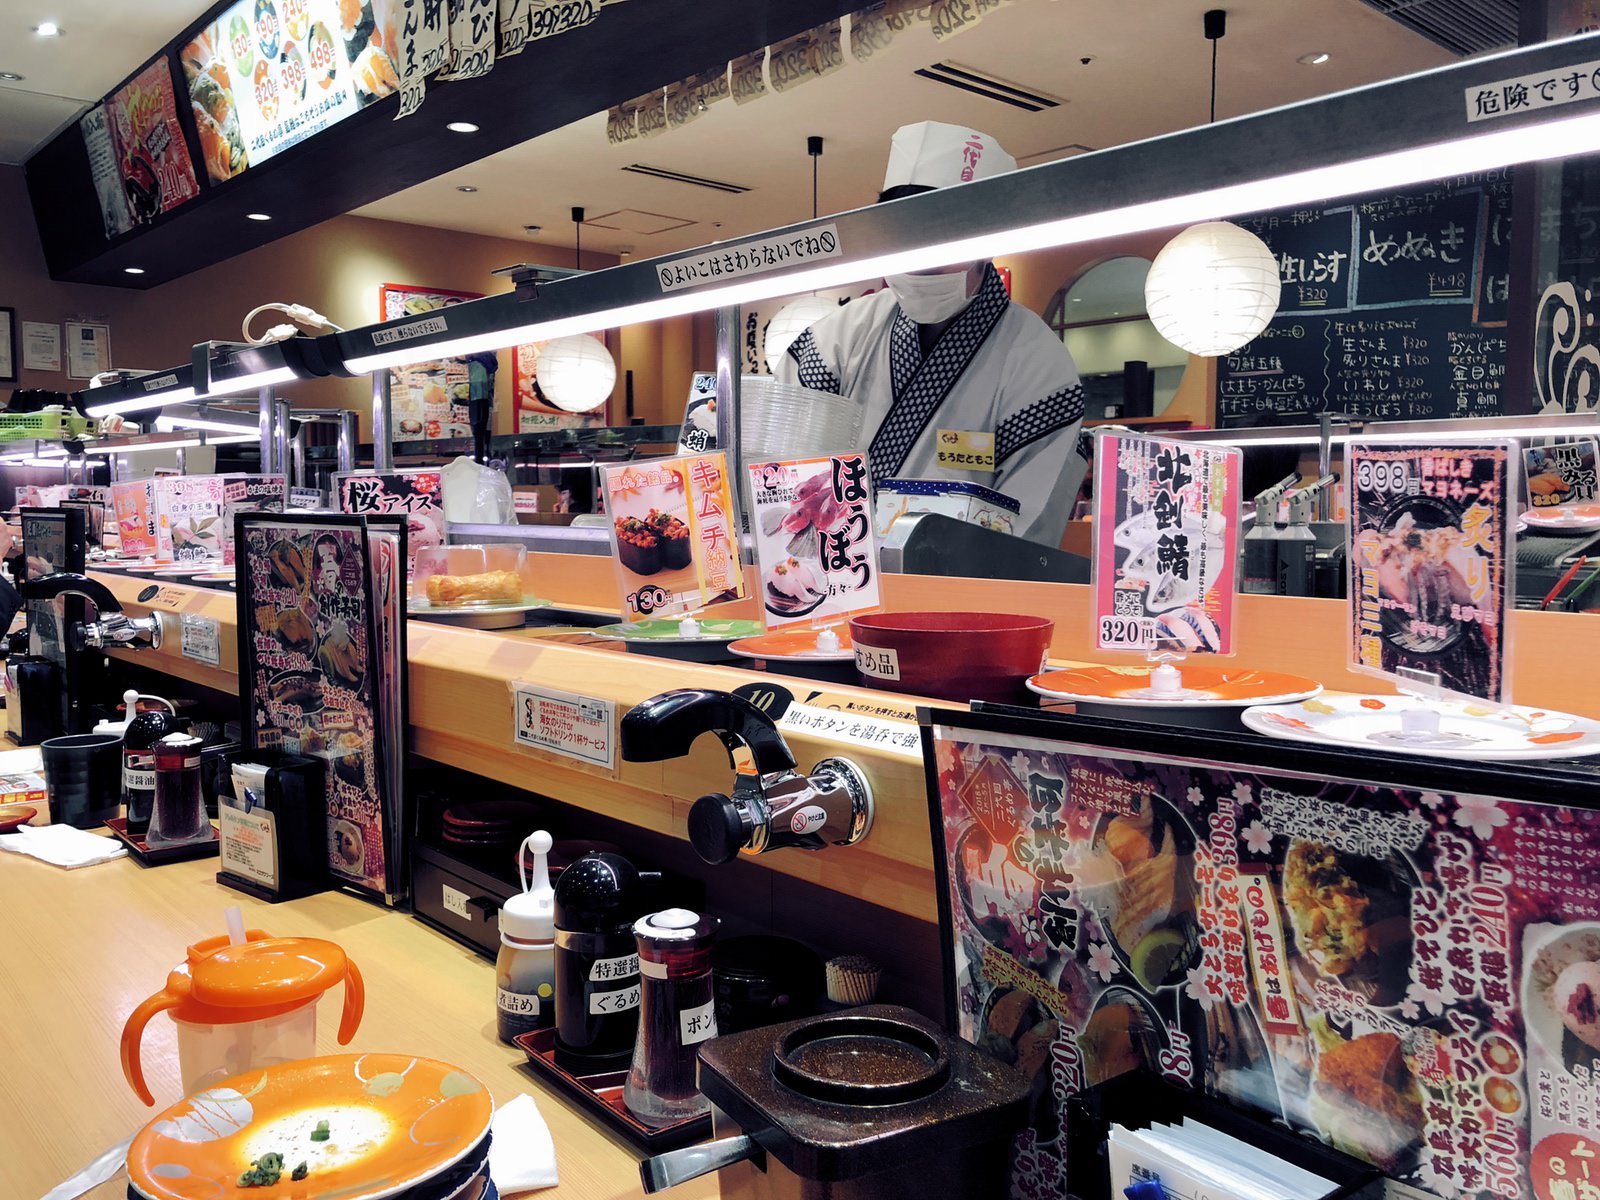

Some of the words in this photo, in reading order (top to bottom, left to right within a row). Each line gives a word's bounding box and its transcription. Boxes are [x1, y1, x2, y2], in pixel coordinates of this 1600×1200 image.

[1475, 72, 1587, 117] 危険です
[675, 236, 821, 283] よいこはさわらないでね
[347, 480, 432, 513] 桜アイス
[691, 459, 731, 592] キムチ納豆
[818, 456, 871, 591] ほうぼう
[1101, 620, 1156, 645] 320円
[1194, 840, 1225, 997] 大とろサーモン
